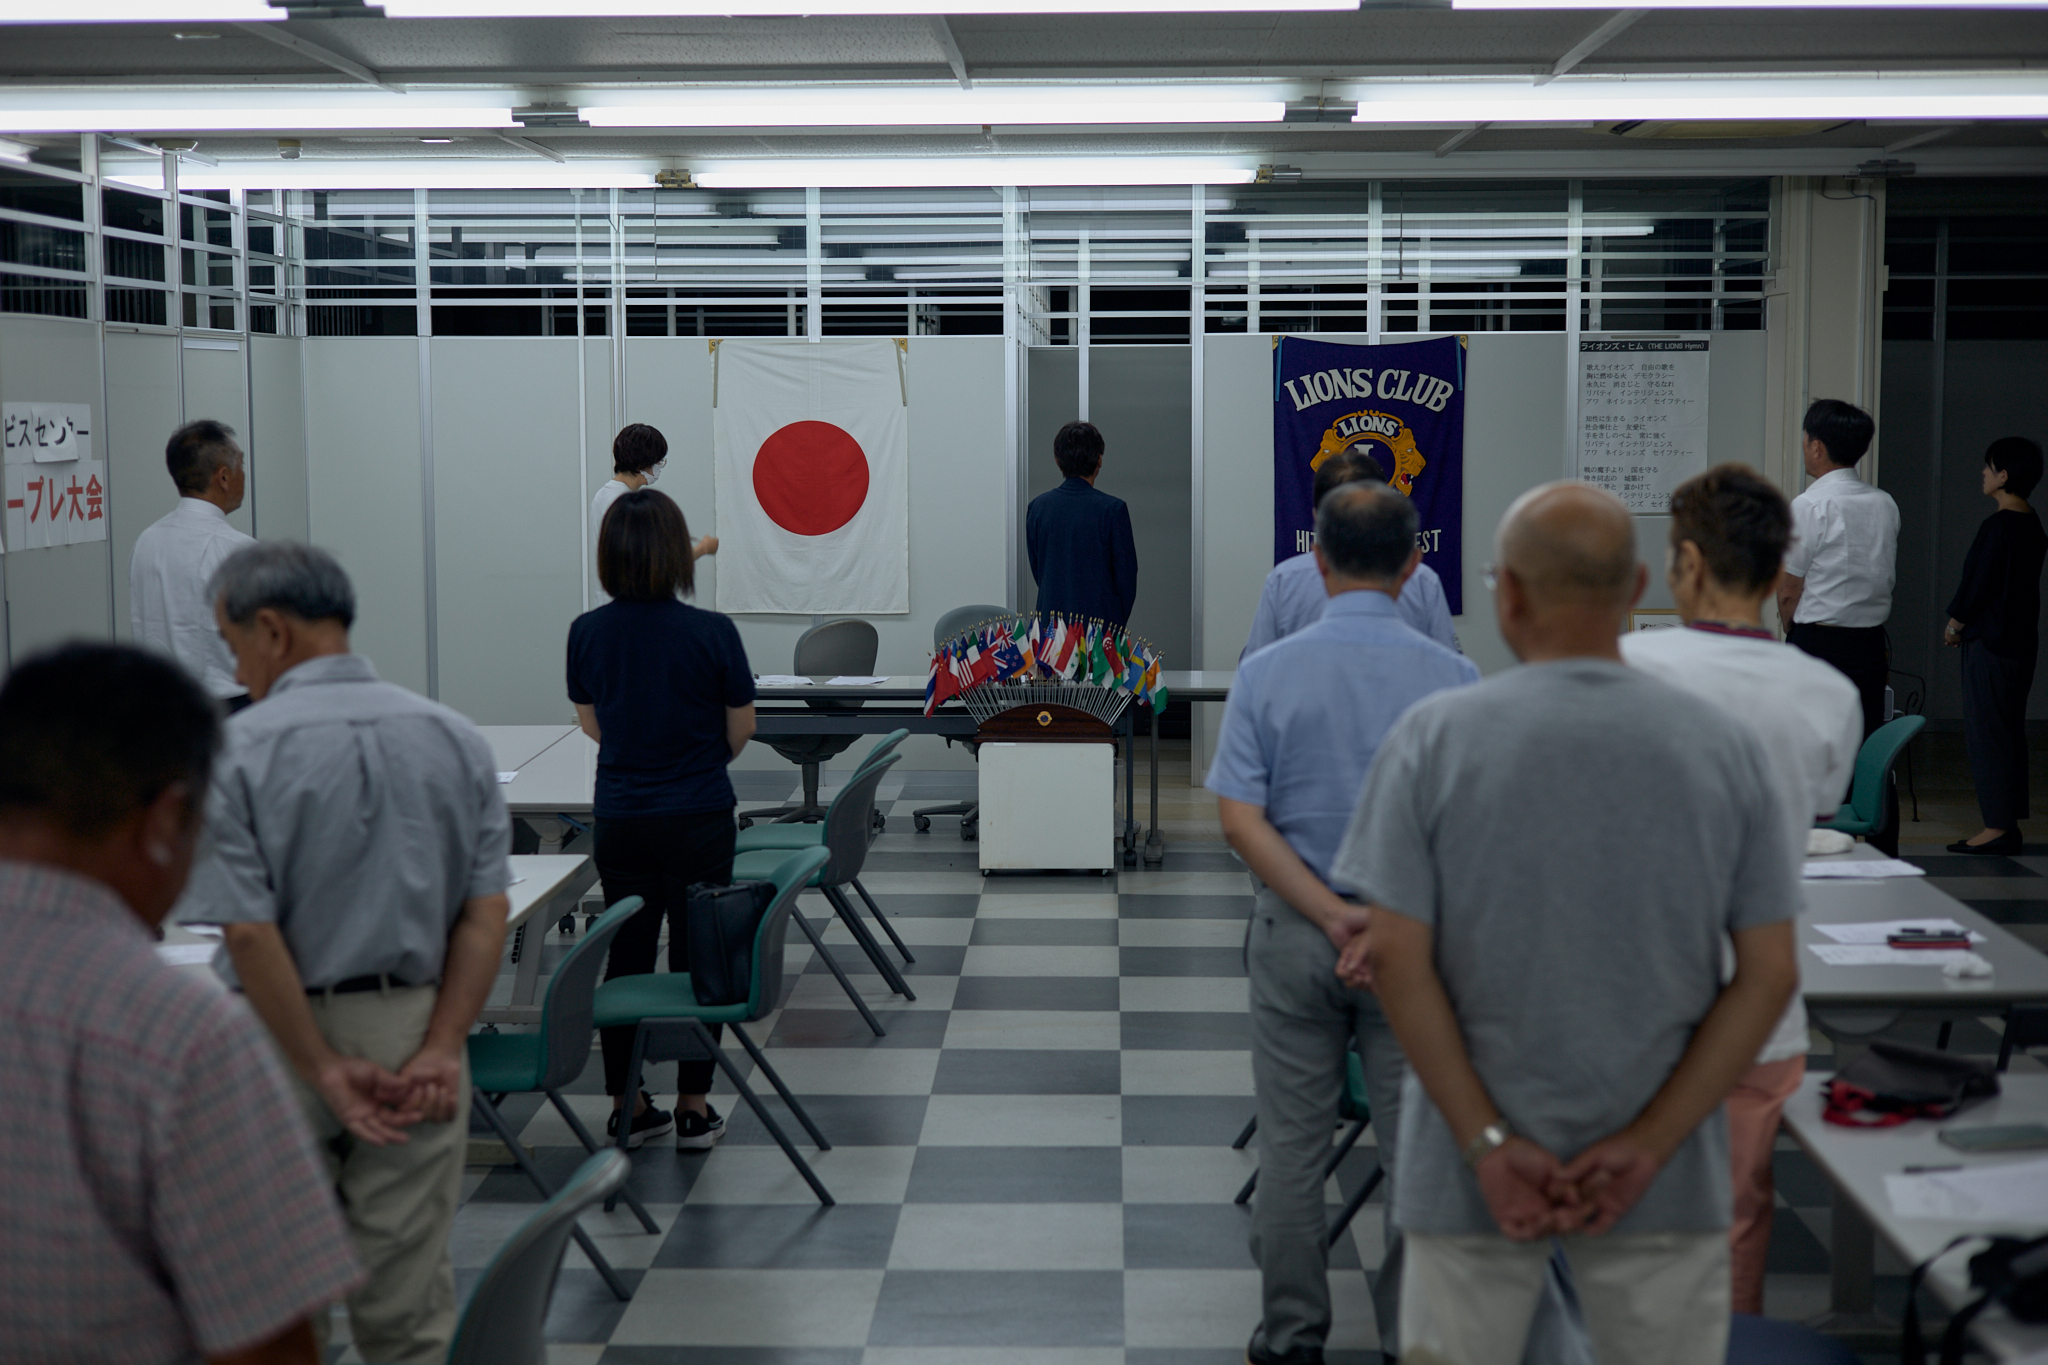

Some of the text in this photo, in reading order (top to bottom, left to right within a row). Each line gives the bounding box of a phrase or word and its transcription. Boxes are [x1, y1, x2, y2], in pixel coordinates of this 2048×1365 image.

[1284, 368, 1454, 412] LIONS CLUB
[1338, 415, 1398, 437] LIONS
[7, 474, 103, 524] ープレ大会
